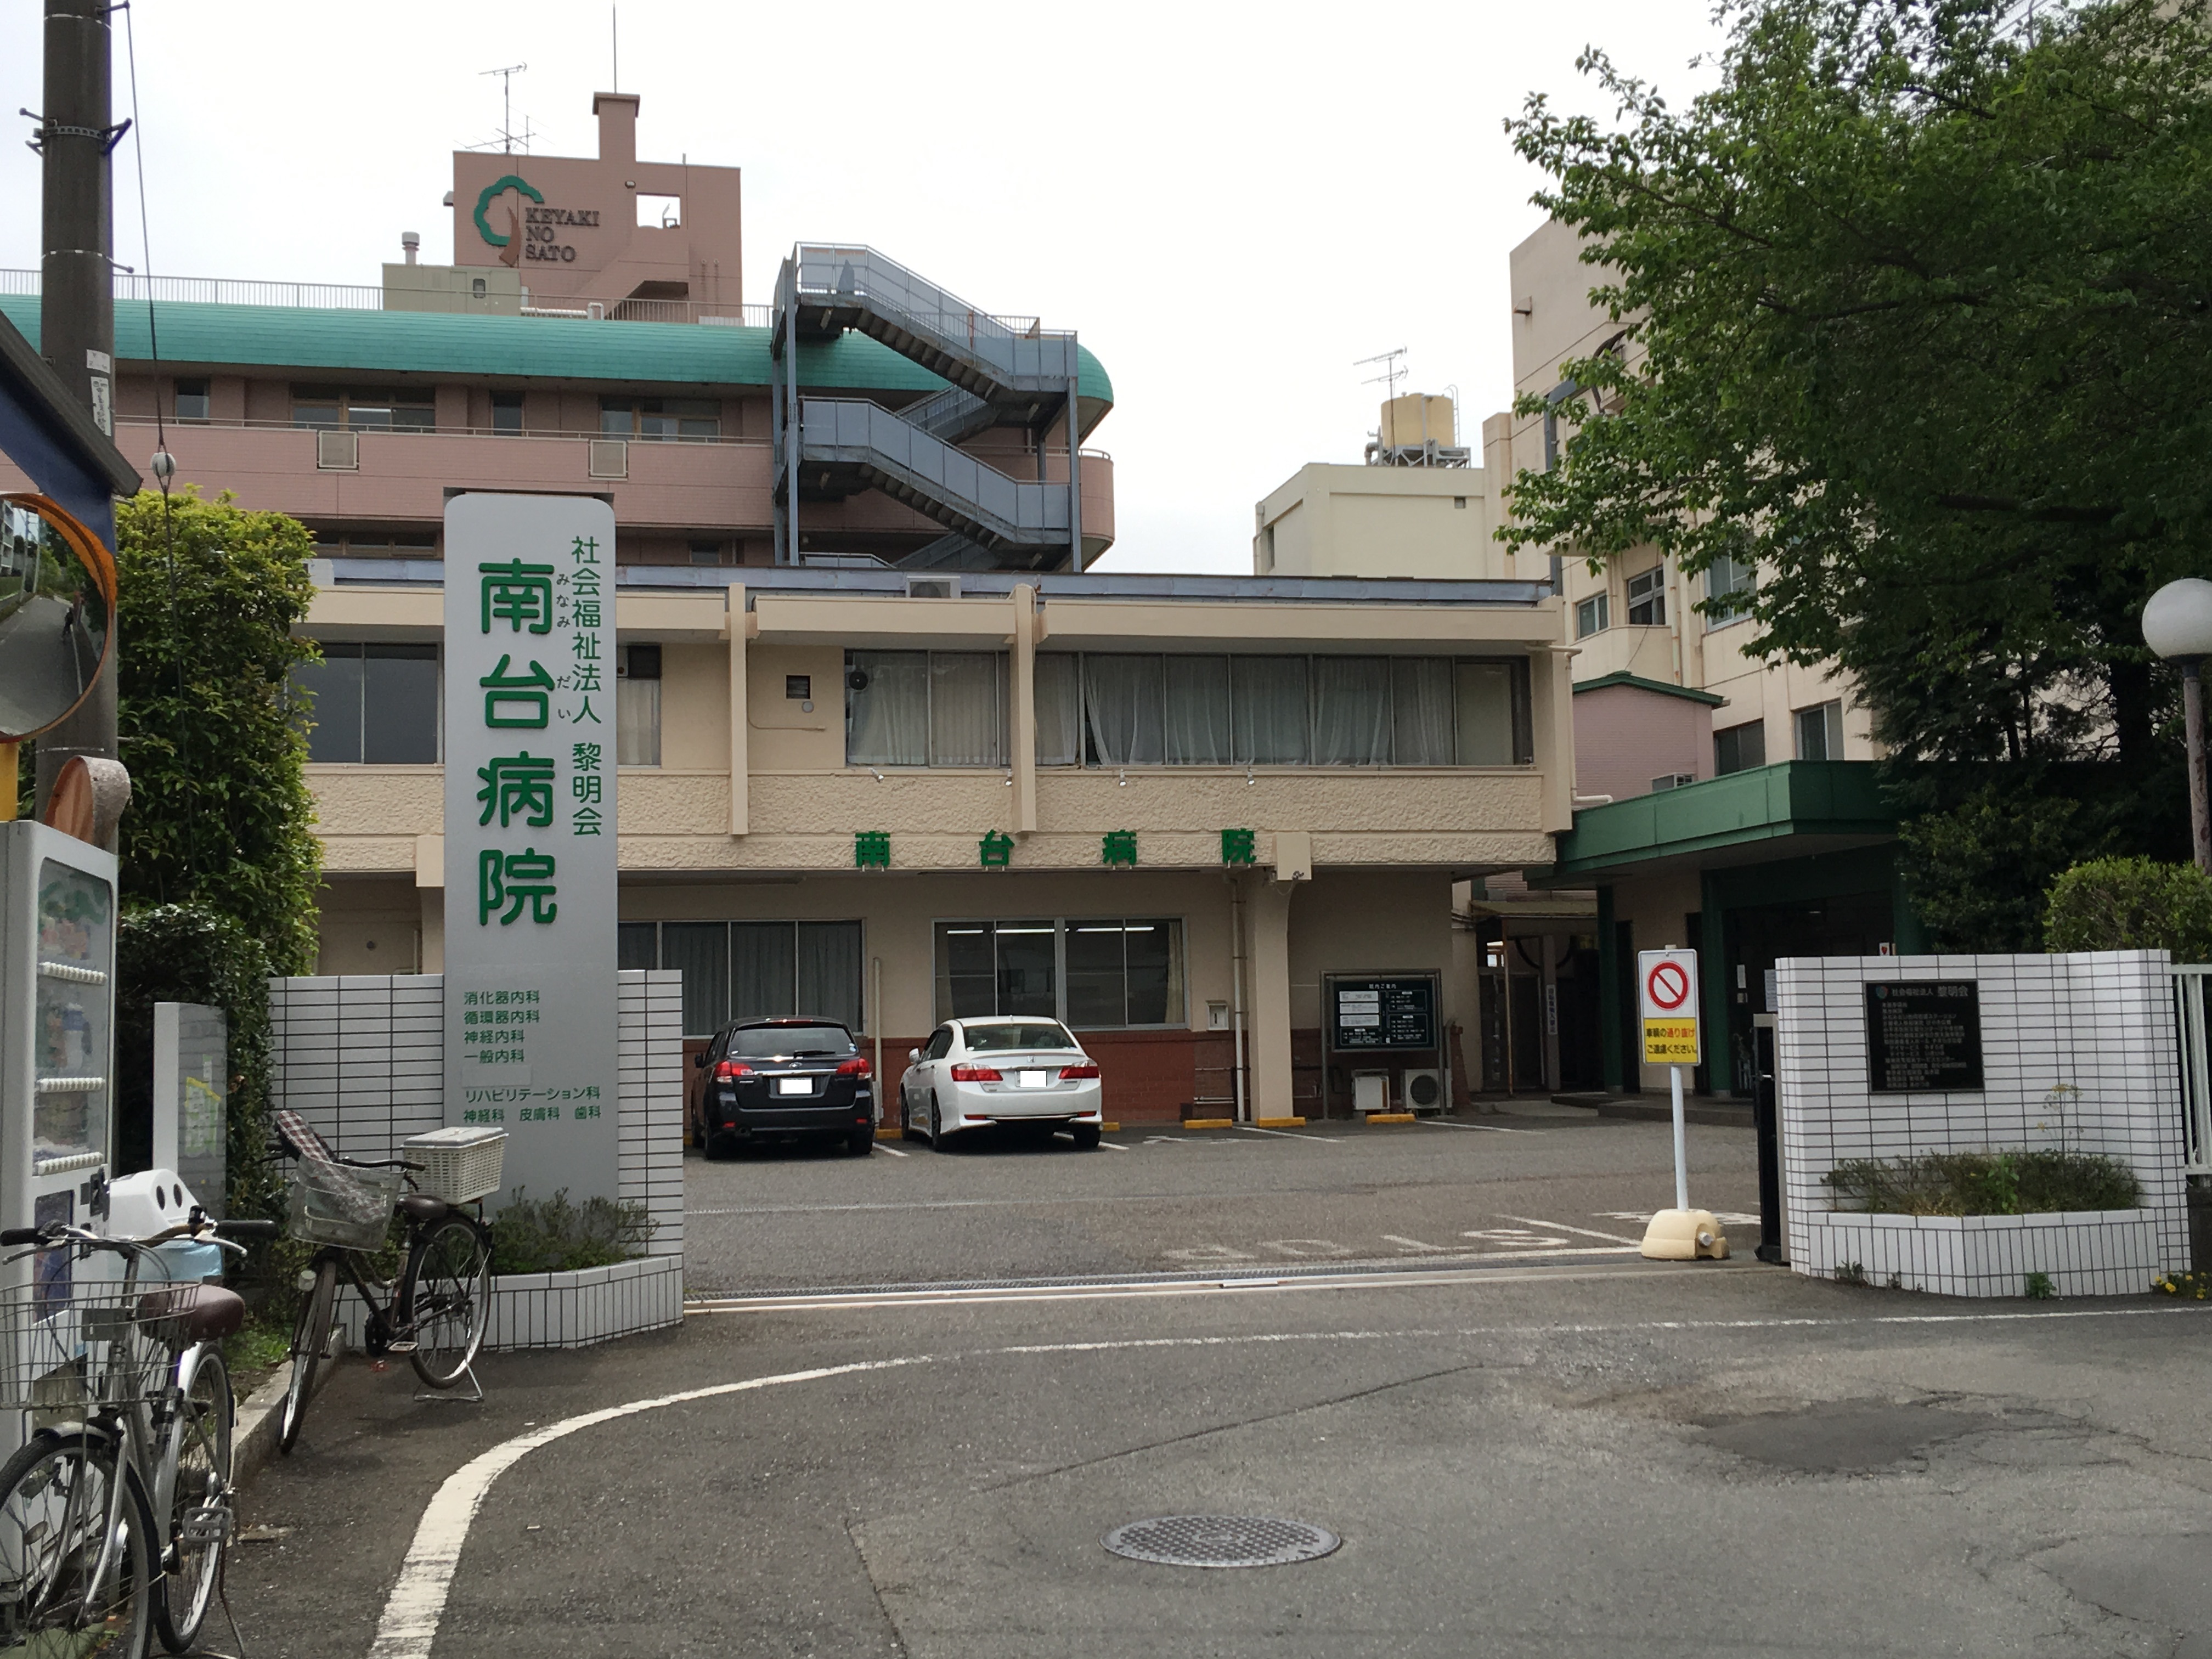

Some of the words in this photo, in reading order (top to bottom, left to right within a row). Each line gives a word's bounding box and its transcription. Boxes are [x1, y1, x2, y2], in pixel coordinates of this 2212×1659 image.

[526, 207, 599, 227] KEYAKI
[526, 226, 554, 244] NO
[525, 244, 576, 262] SATO
[571, 536, 602, 724] 社会福祉法人
[476, 557, 557, 927] 南台病院
[572, 742, 602, 836] 黎明会
[855, 828, 1257, 867] 南台病院
[464, 990, 540, 1005] 消化器内科
[464, 1009, 540, 1025] 循環器内科
[464, 1029, 525, 1045] 神経内科
[464, 1049, 525, 1063] 一般内科
[466, 1085, 601, 1103] リハビリテーション科
[464, 1108, 505, 1123] 神経科
[519, 1106, 560, 1121] 皮膚科
[574, 1105, 601, 1120] 歯科
